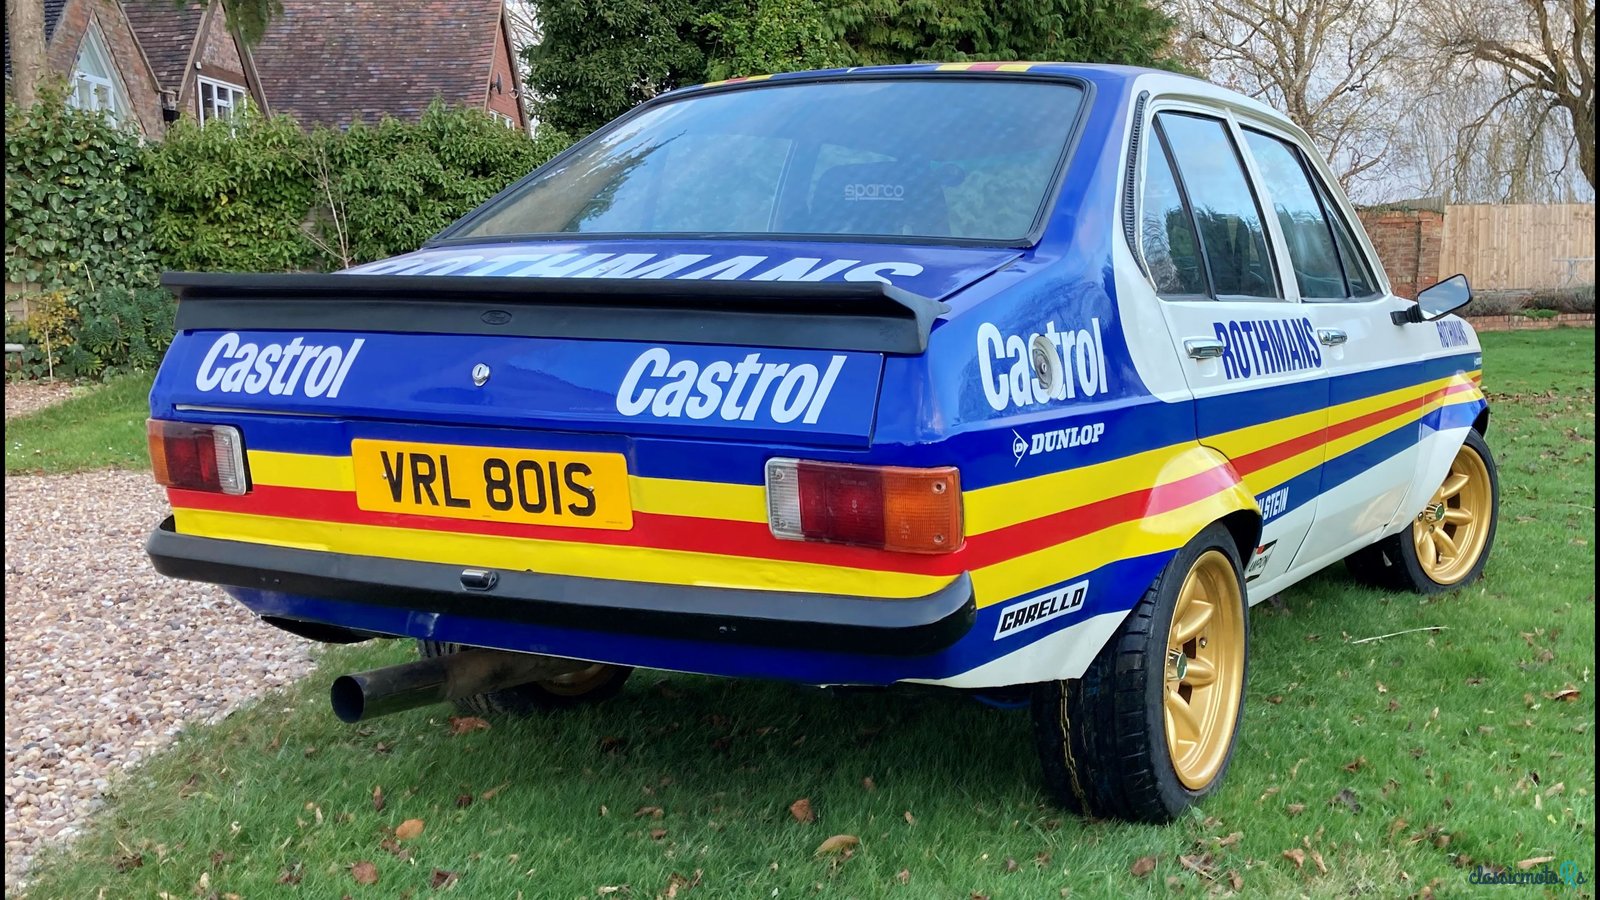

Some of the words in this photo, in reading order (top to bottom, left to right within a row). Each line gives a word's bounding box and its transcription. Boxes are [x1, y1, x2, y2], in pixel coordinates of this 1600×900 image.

[844, 183, 904, 201] sparco
[195, 332, 366, 399] Castrol
[1213, 317, 1322, 380] ROTHMANS
[616, 348, 848, 424] Castrol
[1029, 422, 1105, 456] DUNLOP
[380, 451, 471, 509] VRL
[483, 457, 597, 517] 801S
[999, 587, 1085, 633] CARELLO
